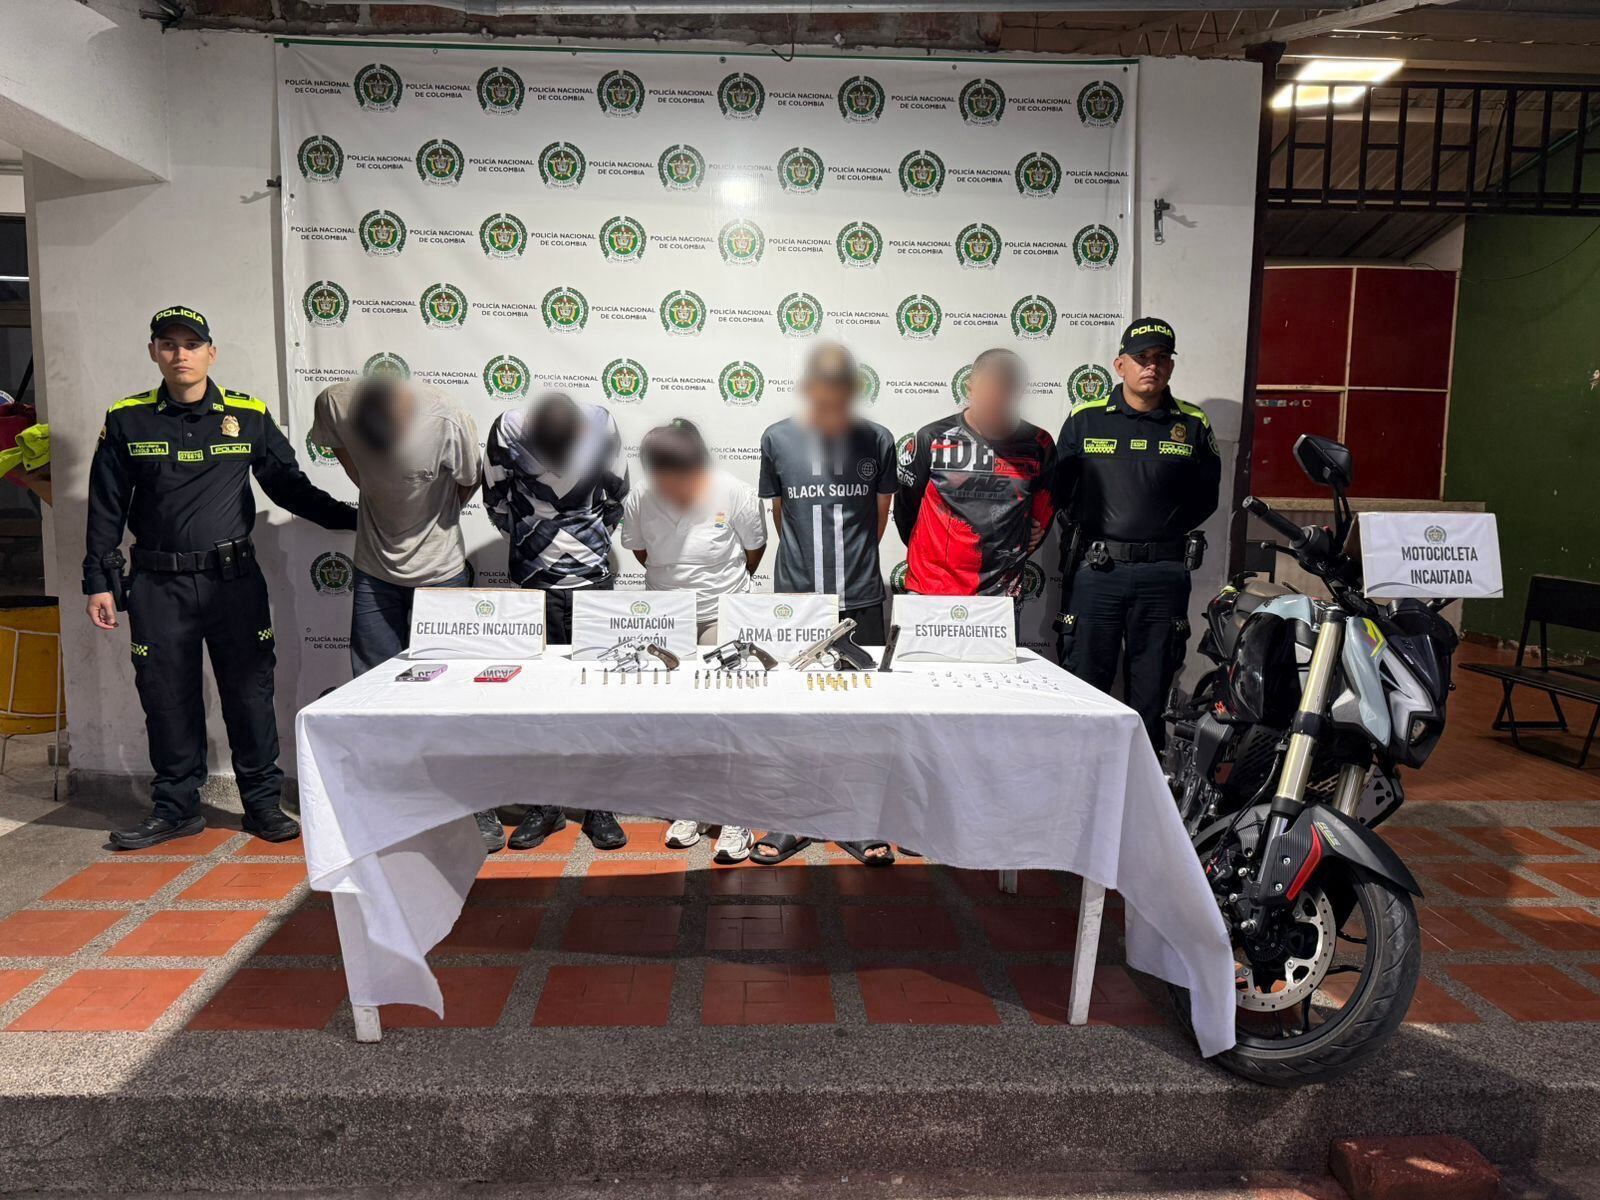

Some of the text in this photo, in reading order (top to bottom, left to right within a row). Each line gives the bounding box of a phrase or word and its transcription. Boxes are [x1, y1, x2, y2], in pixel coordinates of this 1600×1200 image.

[788, 484, 869, 499] BLACK SQUAD
[1401, 547, 1478, 561] MOTOCICLETA
[1411, 569, 1473, 584] INCAUTADA
[416, 621, 543, 636] CELULARES INCAUTADO
[610, 614, 675, 630] INCAUTACIÓN
[738, 627, 773, 642] ARMA
[777, 628, 792, 642] DE
[915, 624, 1007, 638] ESTUPEFACIENTES
